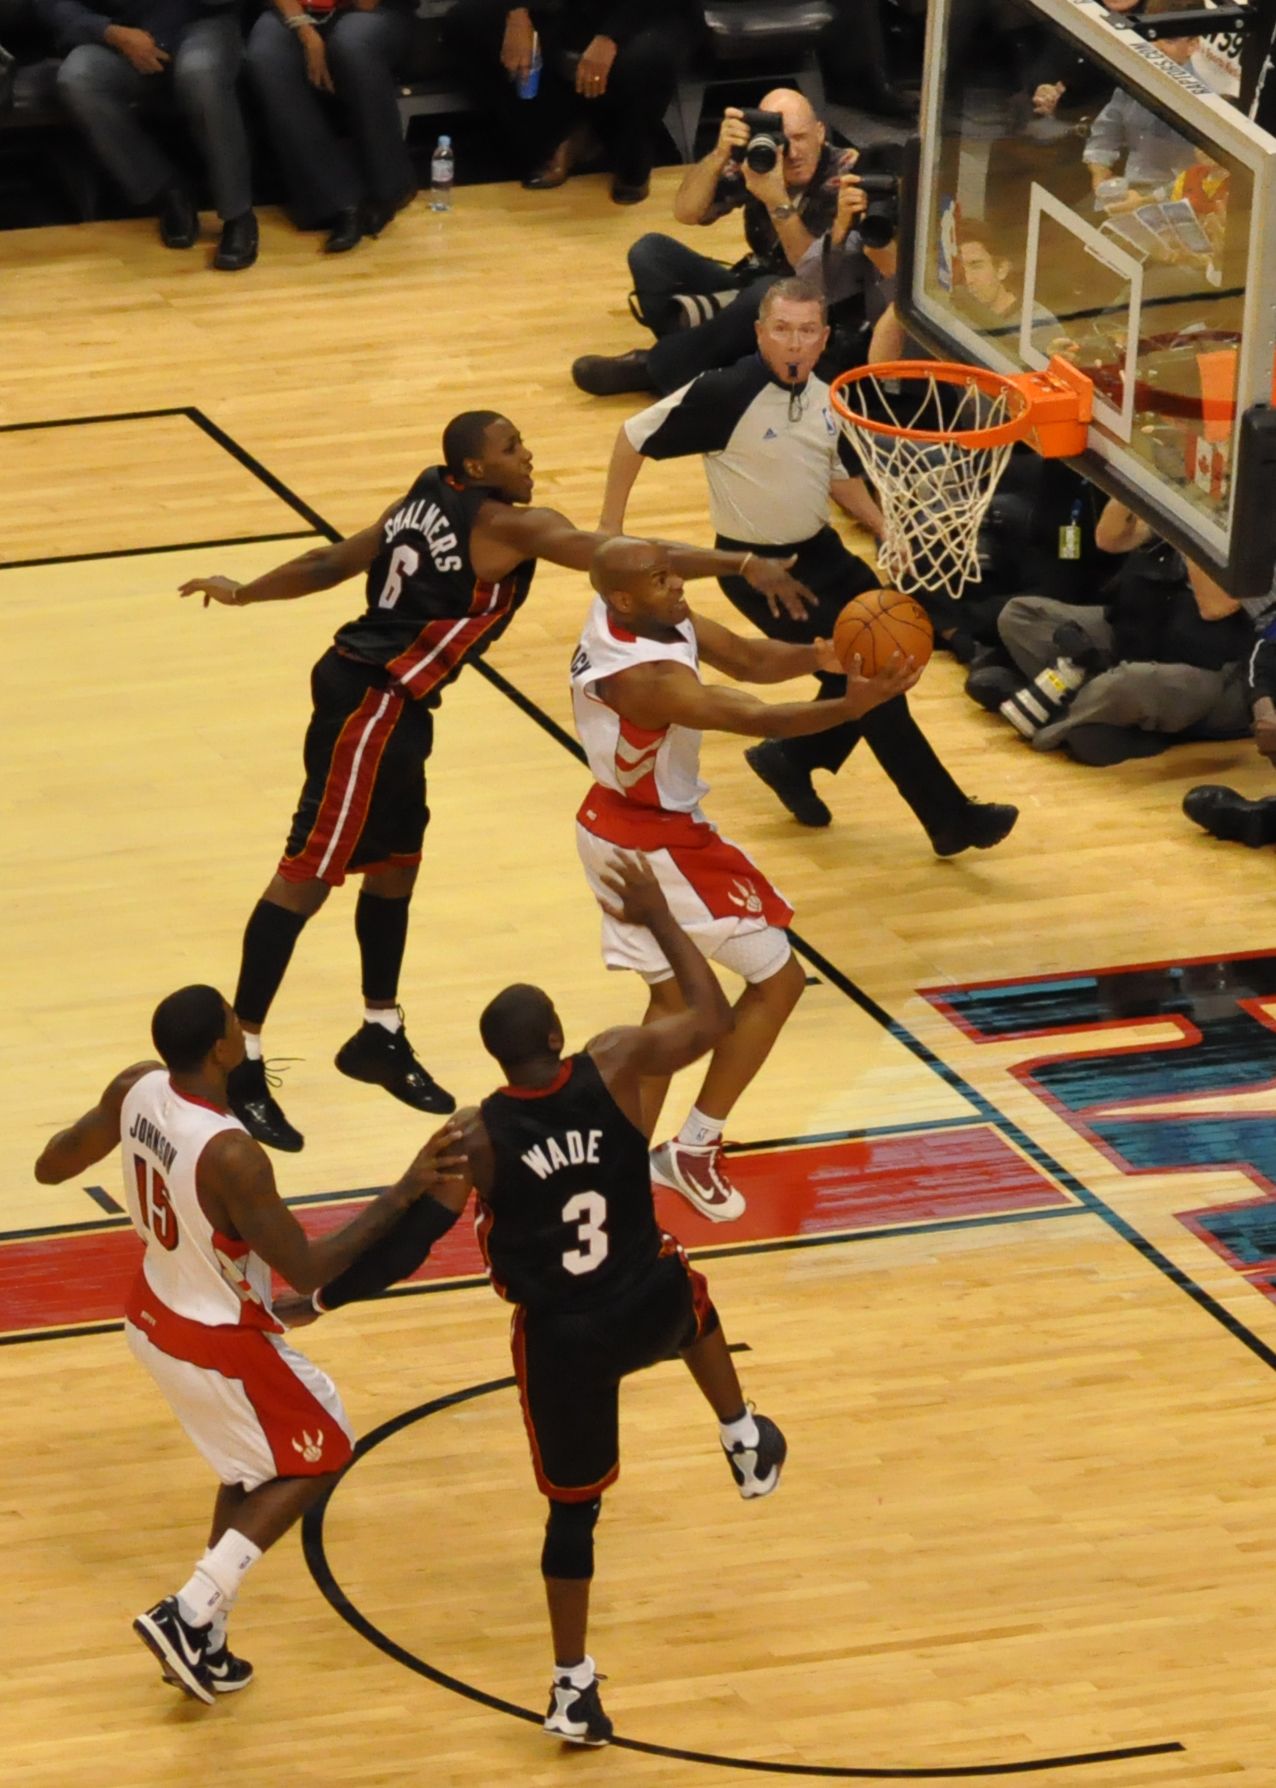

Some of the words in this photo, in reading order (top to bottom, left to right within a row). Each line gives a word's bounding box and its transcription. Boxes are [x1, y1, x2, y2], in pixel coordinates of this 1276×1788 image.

[379, 544, 419, 609] 6
[130, 1114, 178, 1175] JOHNSON
[521, 1129, 603, 1180] WADE
[133, 1153, 180, 1251] 15
[562, 1190, 608, 1276] 3
